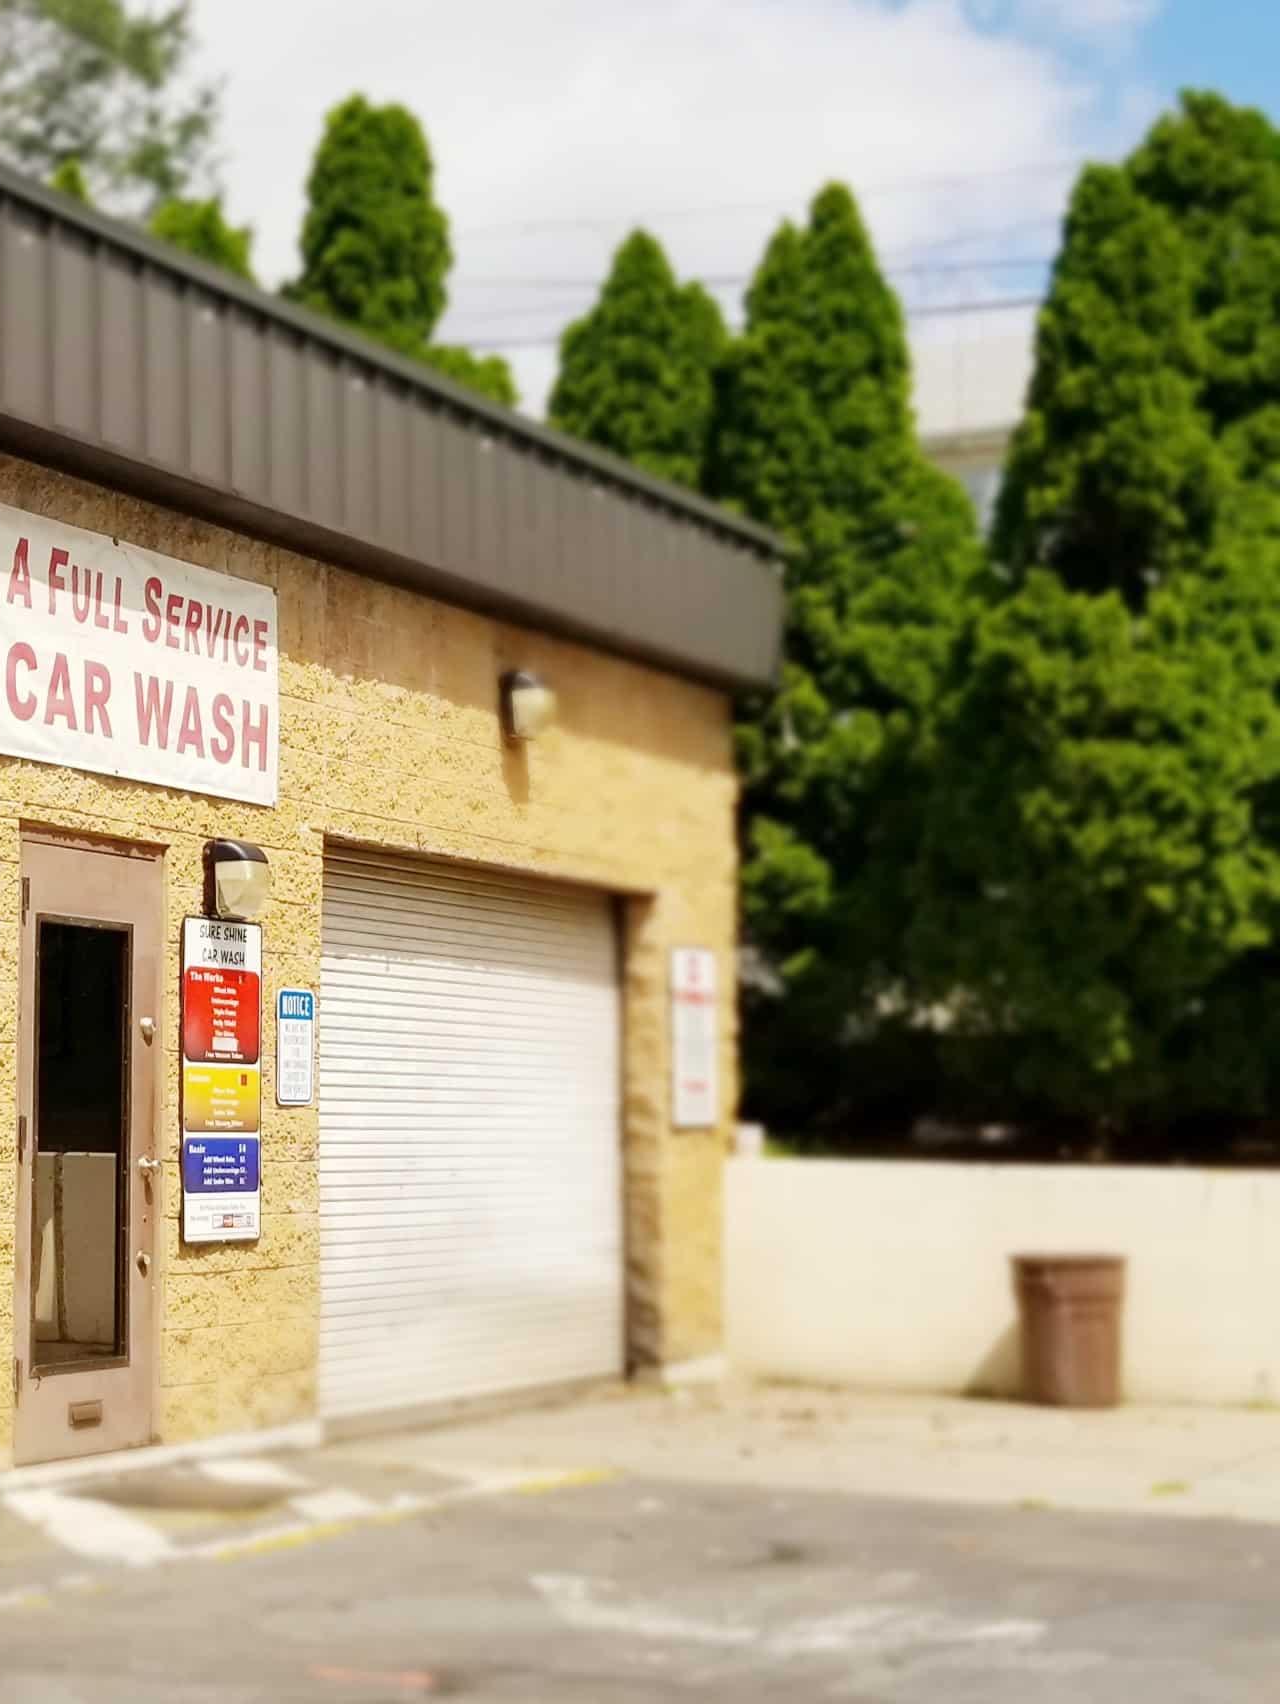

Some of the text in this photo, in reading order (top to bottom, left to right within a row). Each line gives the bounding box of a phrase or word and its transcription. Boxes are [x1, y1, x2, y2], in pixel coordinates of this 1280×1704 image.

[6, 537, 269, 672] A FULL SERVICE
[5, 642, 269, 772] CAR WASH
[200, 925, 247, 943] SURE SHINE
[202, 947, 245, 966] CAR WASH
[282, 994, 310, 1017] NOTICE
